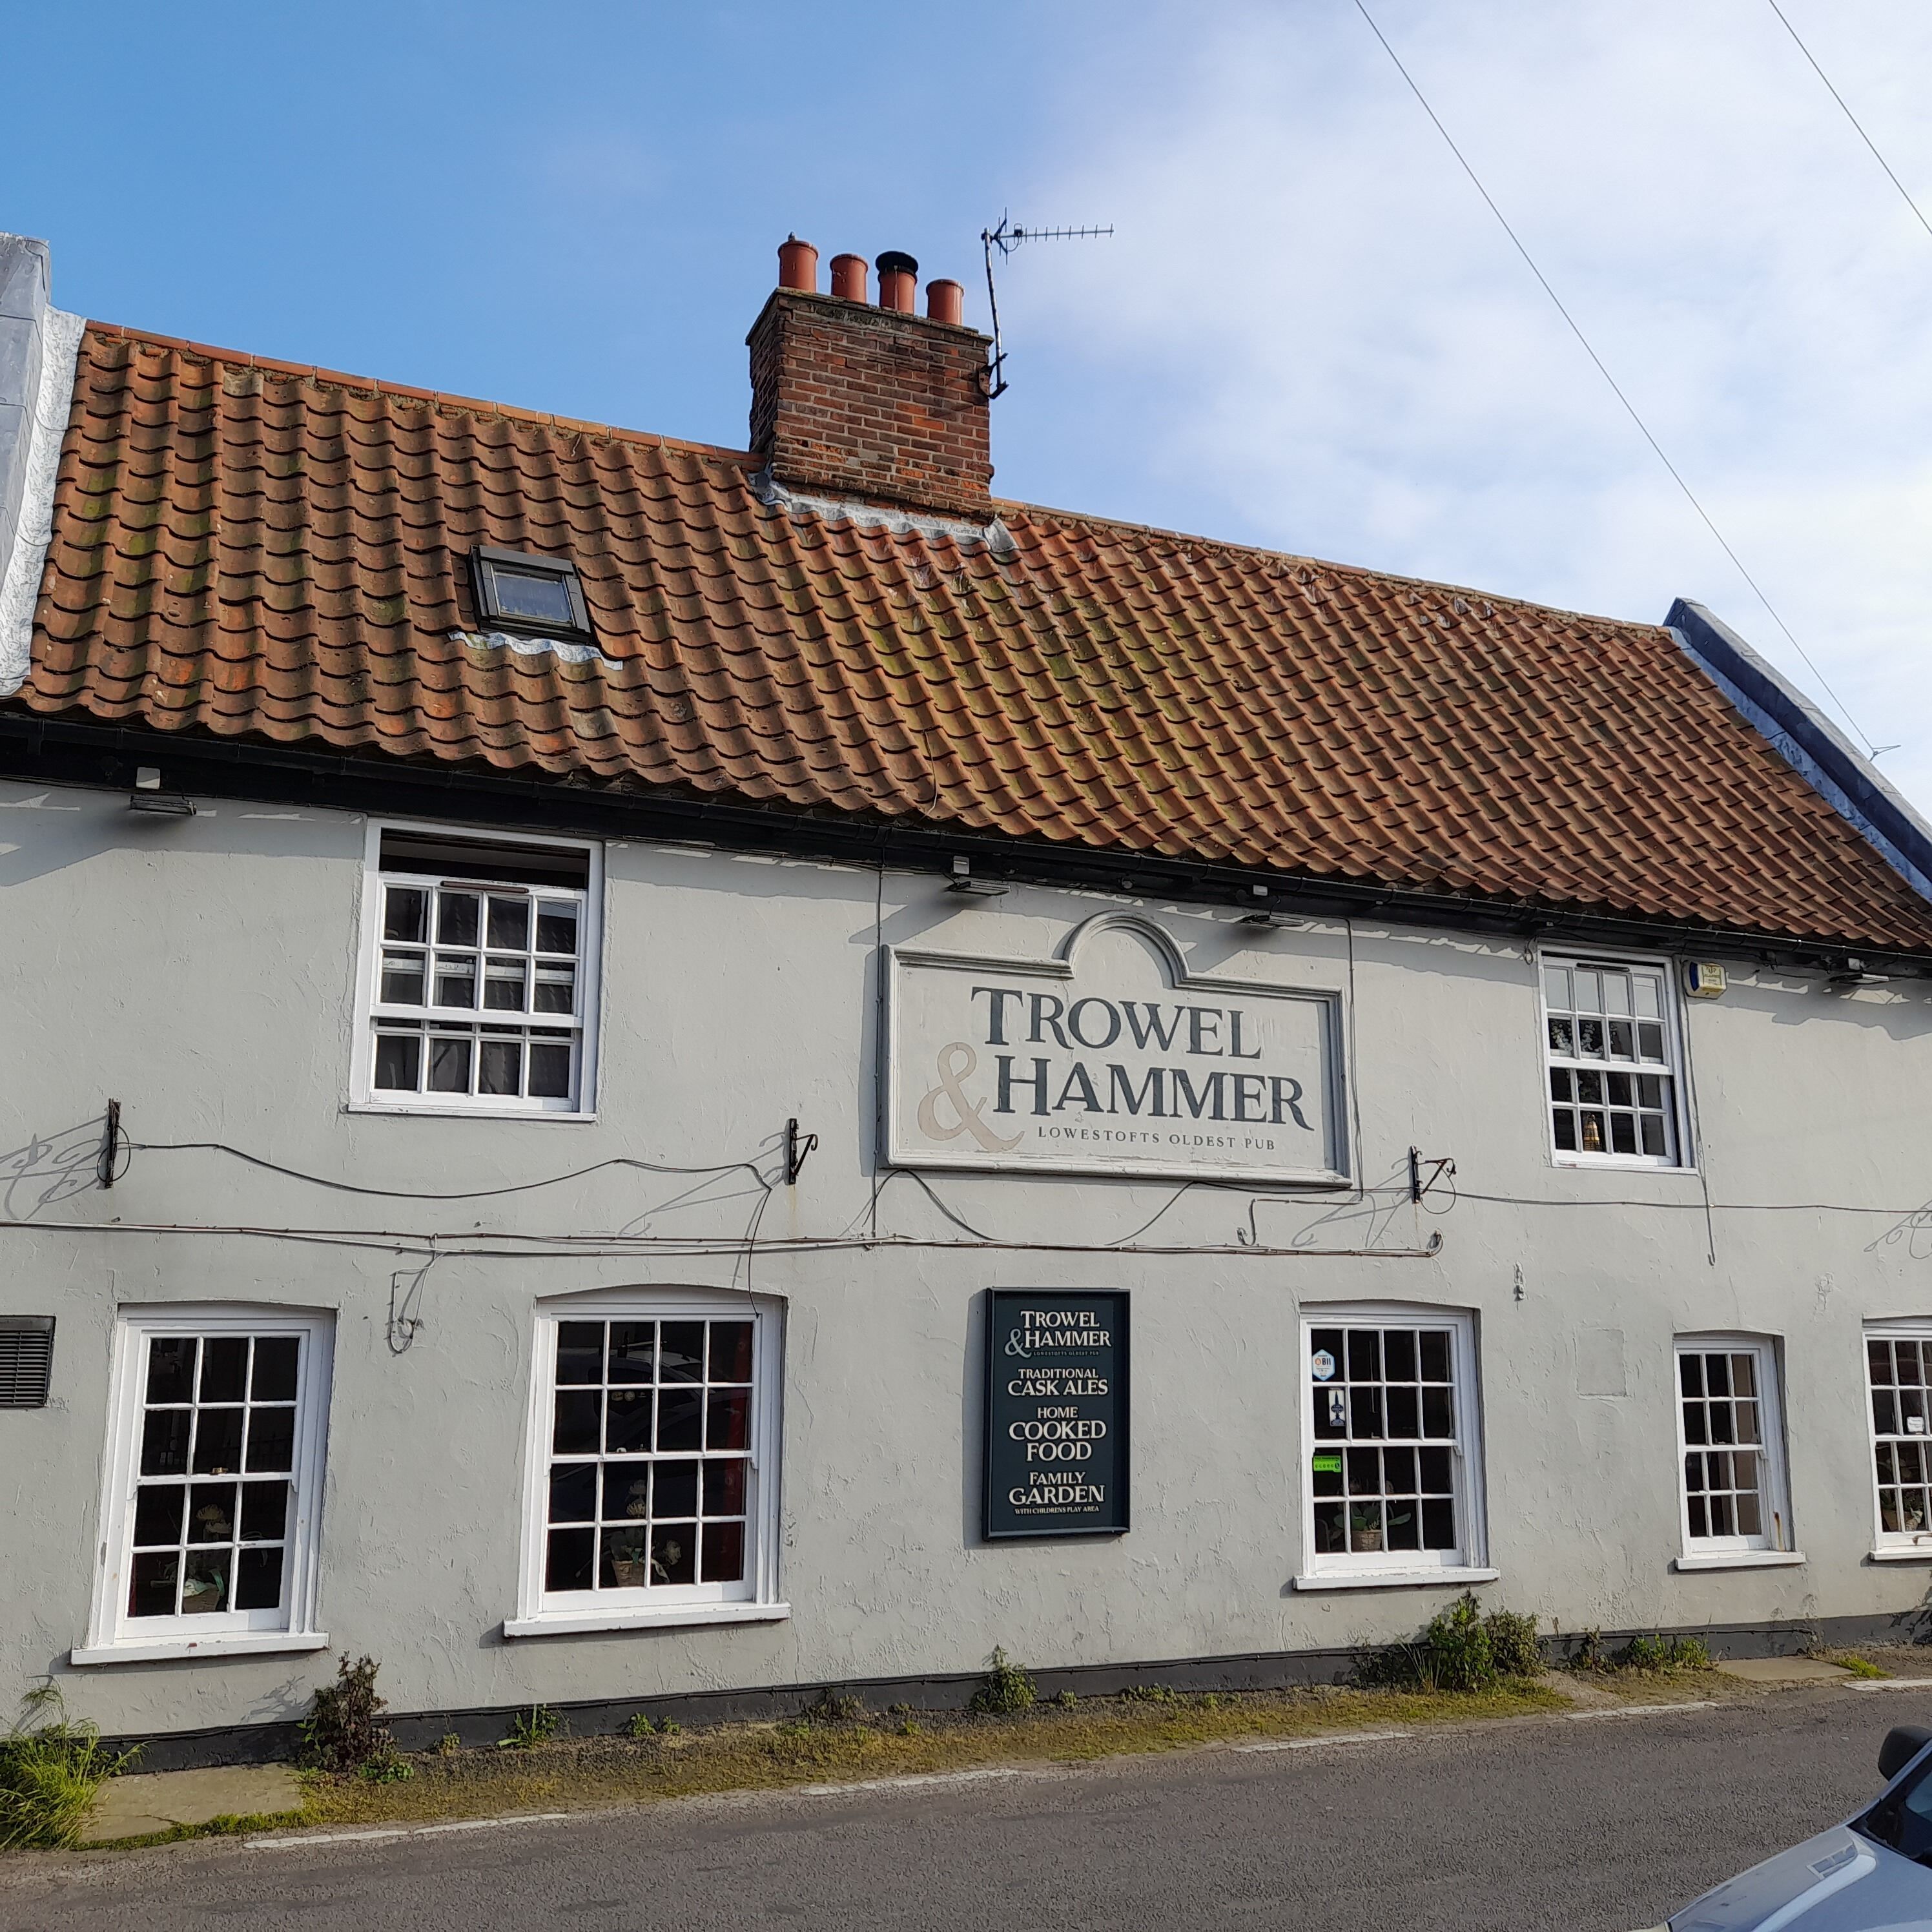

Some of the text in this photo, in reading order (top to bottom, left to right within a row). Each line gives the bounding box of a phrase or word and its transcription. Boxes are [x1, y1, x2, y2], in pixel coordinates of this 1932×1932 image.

[971, 986, 1260, 1059] TROWEL
[918, 1042, 1314, 1153] & HAMMER
[1038, 1126, 1275, 1150] LOWESTOFTS OLDEST PUB
[1020, 1311, 1100, 1328] TROWEL
[1004, 1329, 1111, 1358] & HAMMER
[1018, 1368, 1098, 1379] TRADITIONAL
[1008, 1379, 1108, 1396] CASK ALES
[1038, 1406, 1078, 1419] HOME
[1009, 1420, 1107, 1440] COOKED
[1027, 1441, 1092, 1461] FOOD
[1030, 1472, 1085, 1485] FAMILY
[1009, 1485, 1105, 1505] GARDEN
